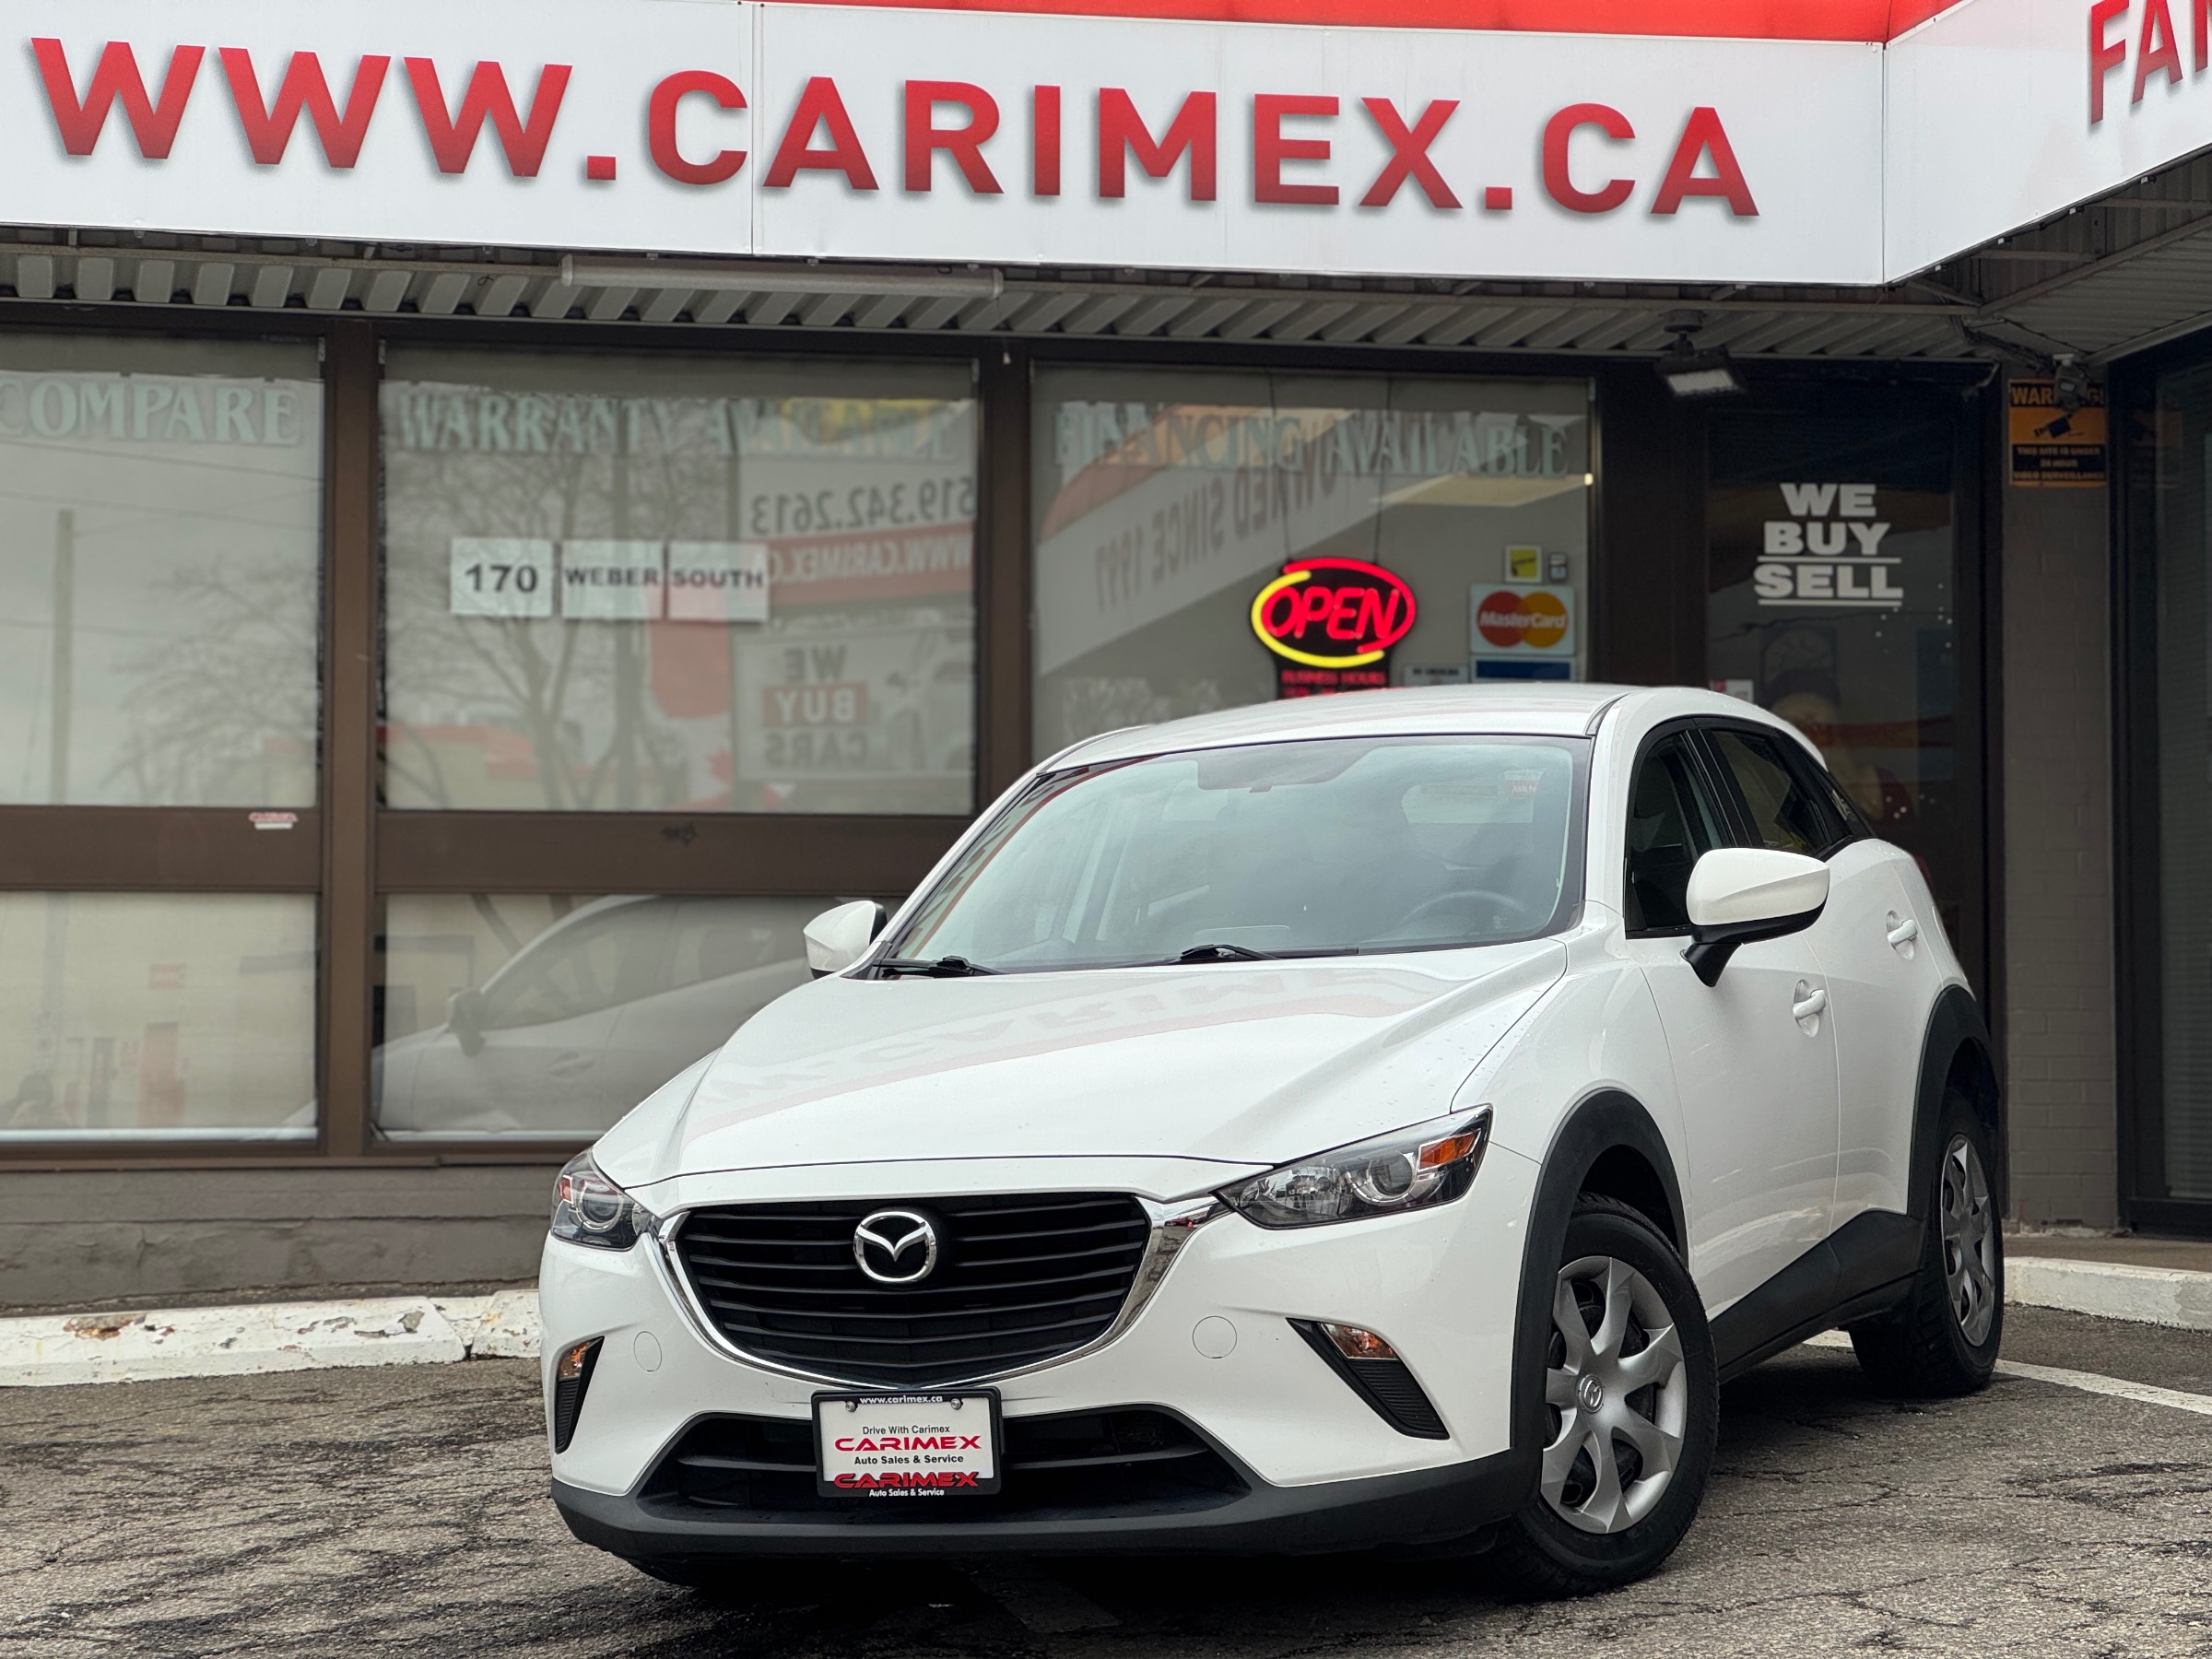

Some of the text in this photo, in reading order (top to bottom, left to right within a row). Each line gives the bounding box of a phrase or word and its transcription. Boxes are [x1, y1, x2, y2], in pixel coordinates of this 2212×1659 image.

[30, 37, 1759, 218] WWW.CARIMEX.CA
[2011, 386, 2104, 406] WARG!
[399, 391, 675, 453] WARRANTY
[1324, 418, 1567, 477] AVAILABLE
[1780, 483, 1877, 517] WE
[1764, 522, 1890, 556] BUY
[465, 564, 763, 593] 170 WEBER SOUTH
[1754, 564, 1903, 598] SELL
[1261, 586, 1400, 640] OPEN
[1478, 611, 1567, 630] MasterCard
[859, 1394, 944, 1405] www.carimex.ca
[863, 1425, 950, 1435] Drive With Carimex
[834, 1435, 982, 1452] CARIMEX
[854, 1454, 964, 1465] Auto Sales & Service
[833, 1471, 979, 1488] CARIMEX
[868, 1488, 887, 1497] Auto
[888, 1488, 908, 1497] Sales
